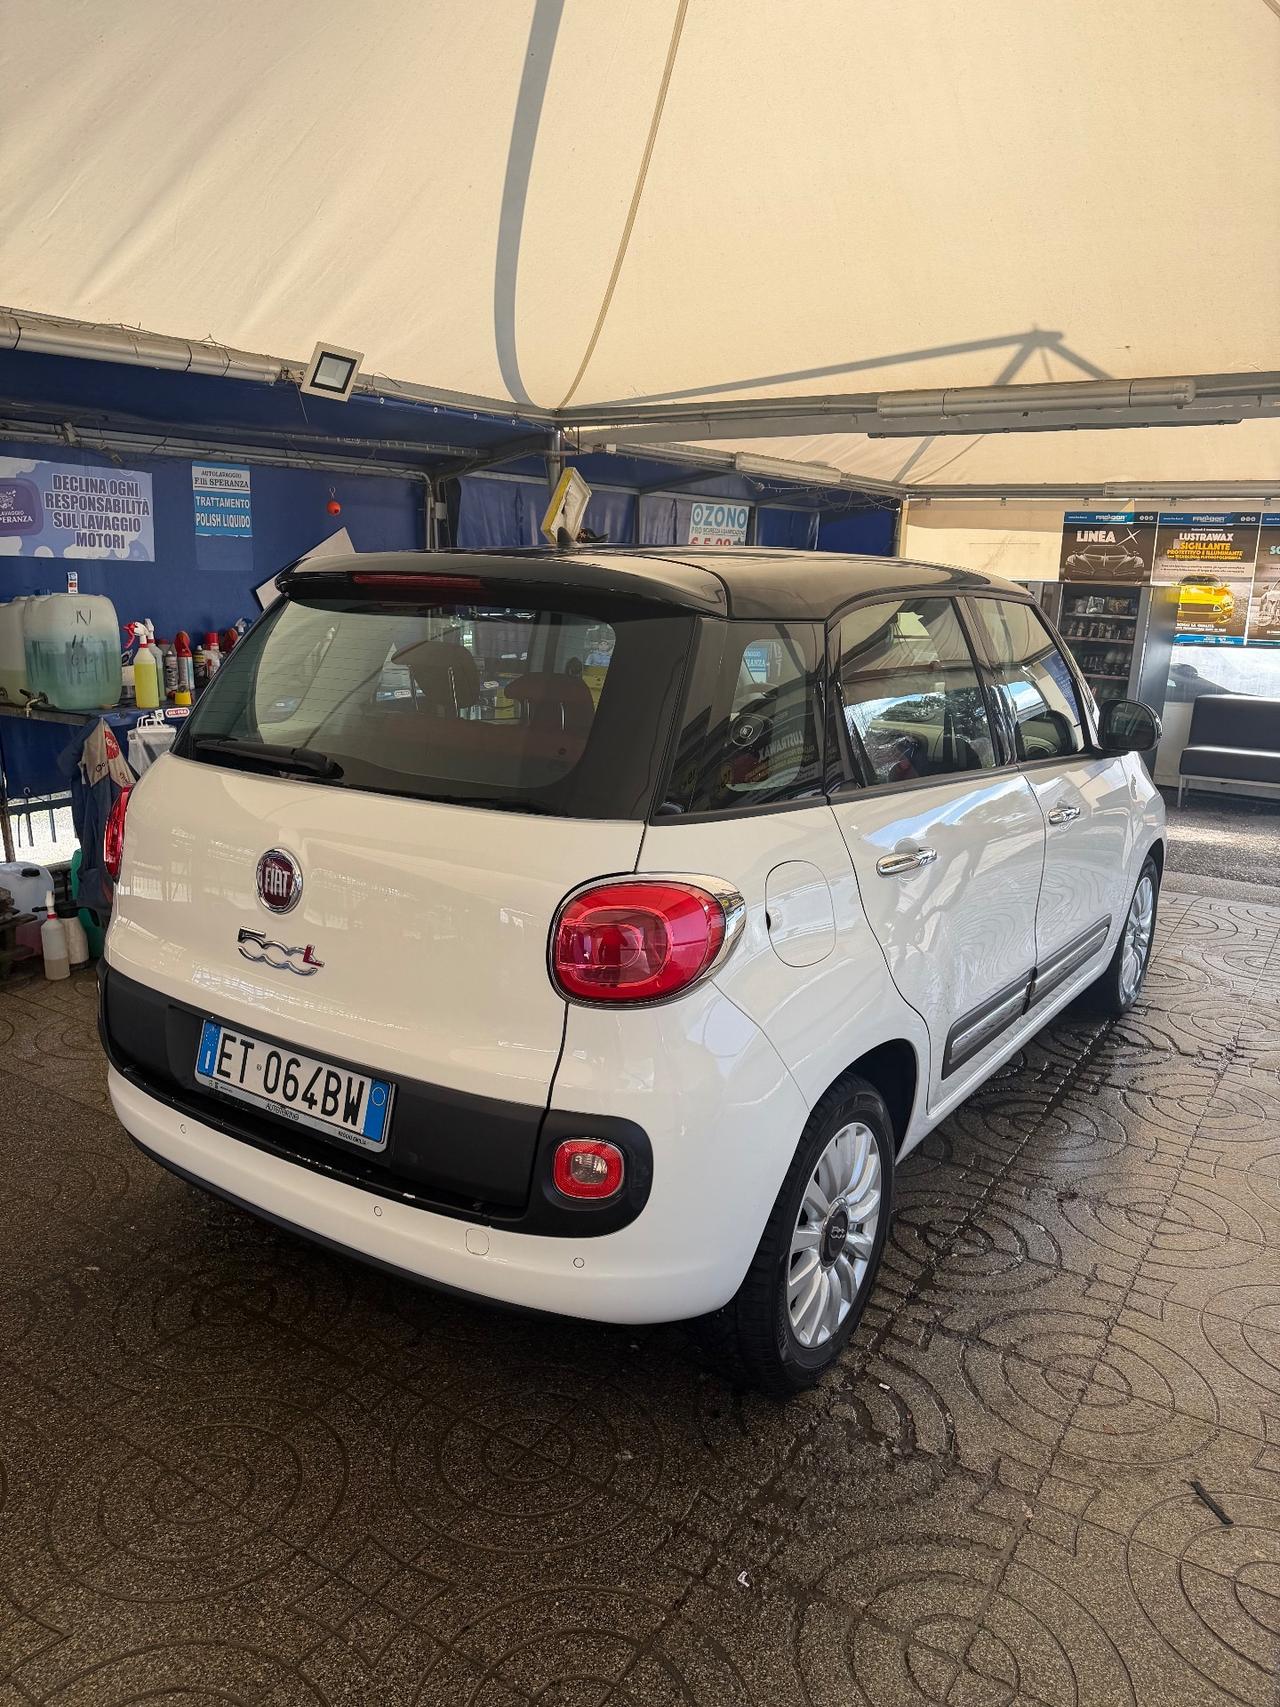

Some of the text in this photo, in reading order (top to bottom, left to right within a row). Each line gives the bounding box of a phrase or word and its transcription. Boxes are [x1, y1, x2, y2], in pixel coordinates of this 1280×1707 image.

[52, 474, 139, 498] DECLINA OGNI
[209, 478, 249, 488] SPERANZA
[45, 492, 150, 516] RESPONSABILITÀ
[195, 496, 250, 509] TRATTAMENTO
[53, 511, 141, 533] SUL LAVAGGIO
[195, 513, 251, 528] POLISH LIQUIDO
[692, 503, 748, 529] OZONO
[75, 532, 125, 549] MOTORI
[1076, 530, 1116, 543] LINEA
[1179, 532, 1234, 542] LUSTRAWAX
[1180, 542, 1231, 551] SIGILLANTE
[264, 865, 291, 898] FIAT
[237, 925, 325, 977] 500L
